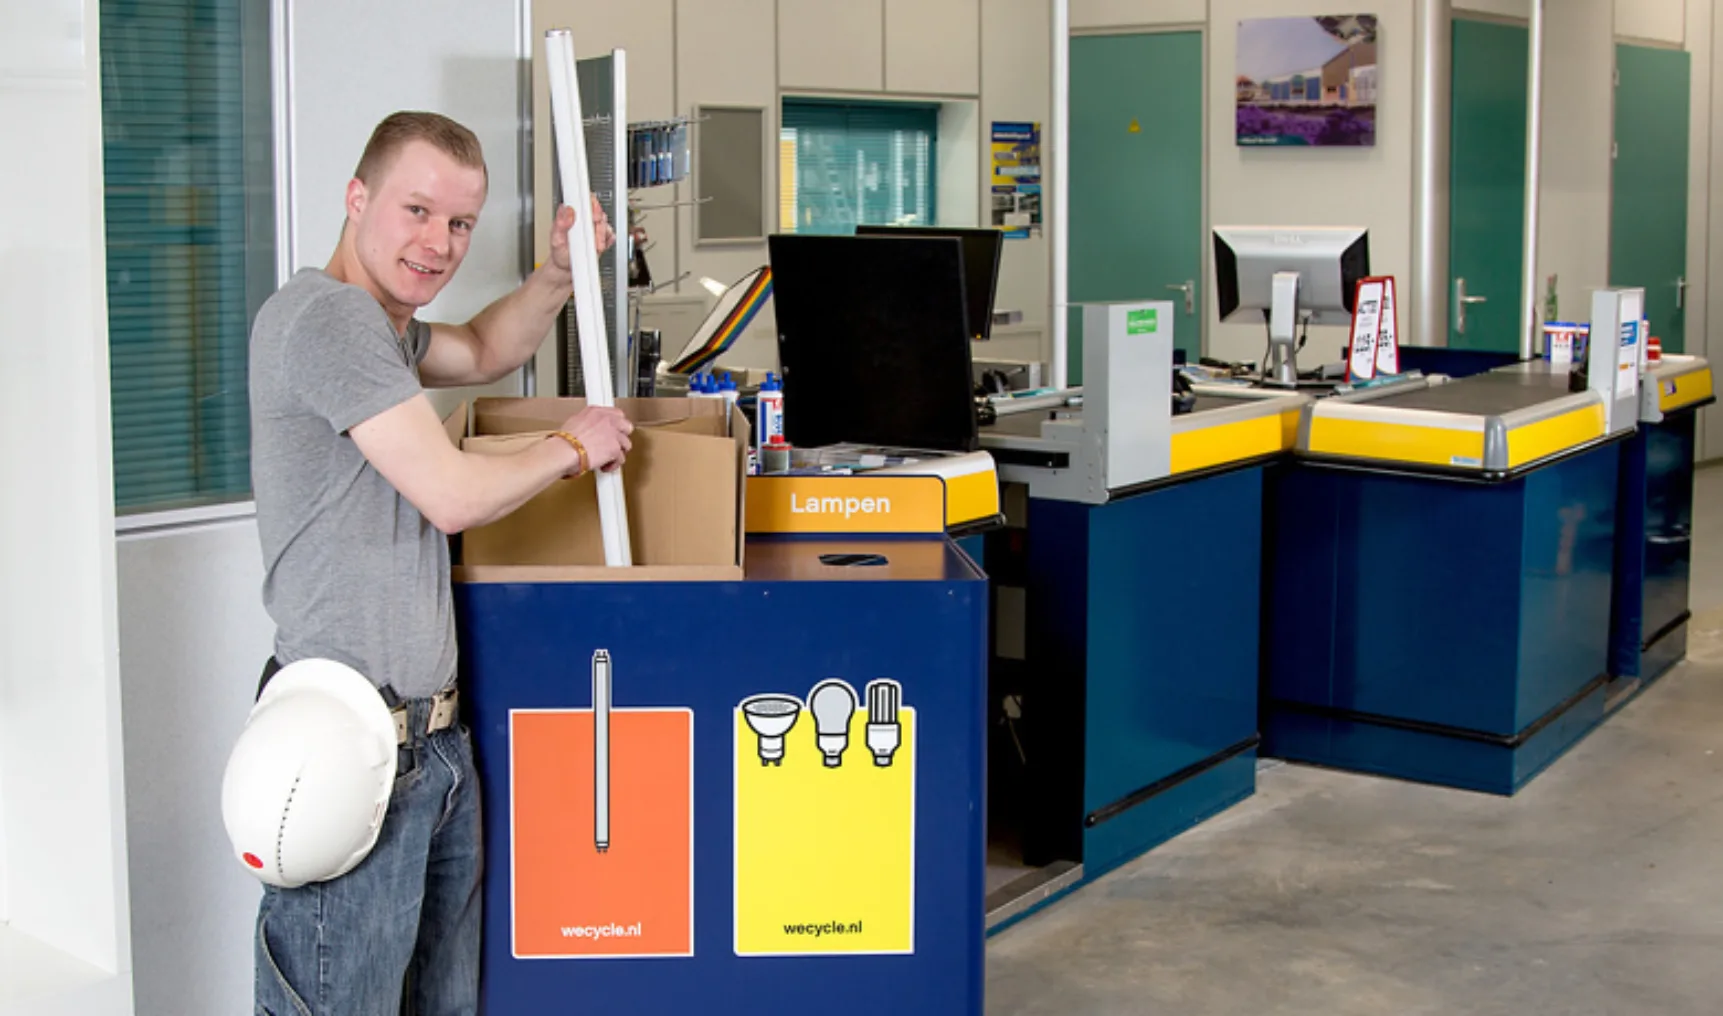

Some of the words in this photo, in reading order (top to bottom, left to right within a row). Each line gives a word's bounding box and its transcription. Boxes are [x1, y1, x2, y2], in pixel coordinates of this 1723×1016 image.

[791, 492, 891, 519] Lampen
[560, 921, 642, 941] wecycle.nl
[783, 919, 862, 938] wecycle.nl
